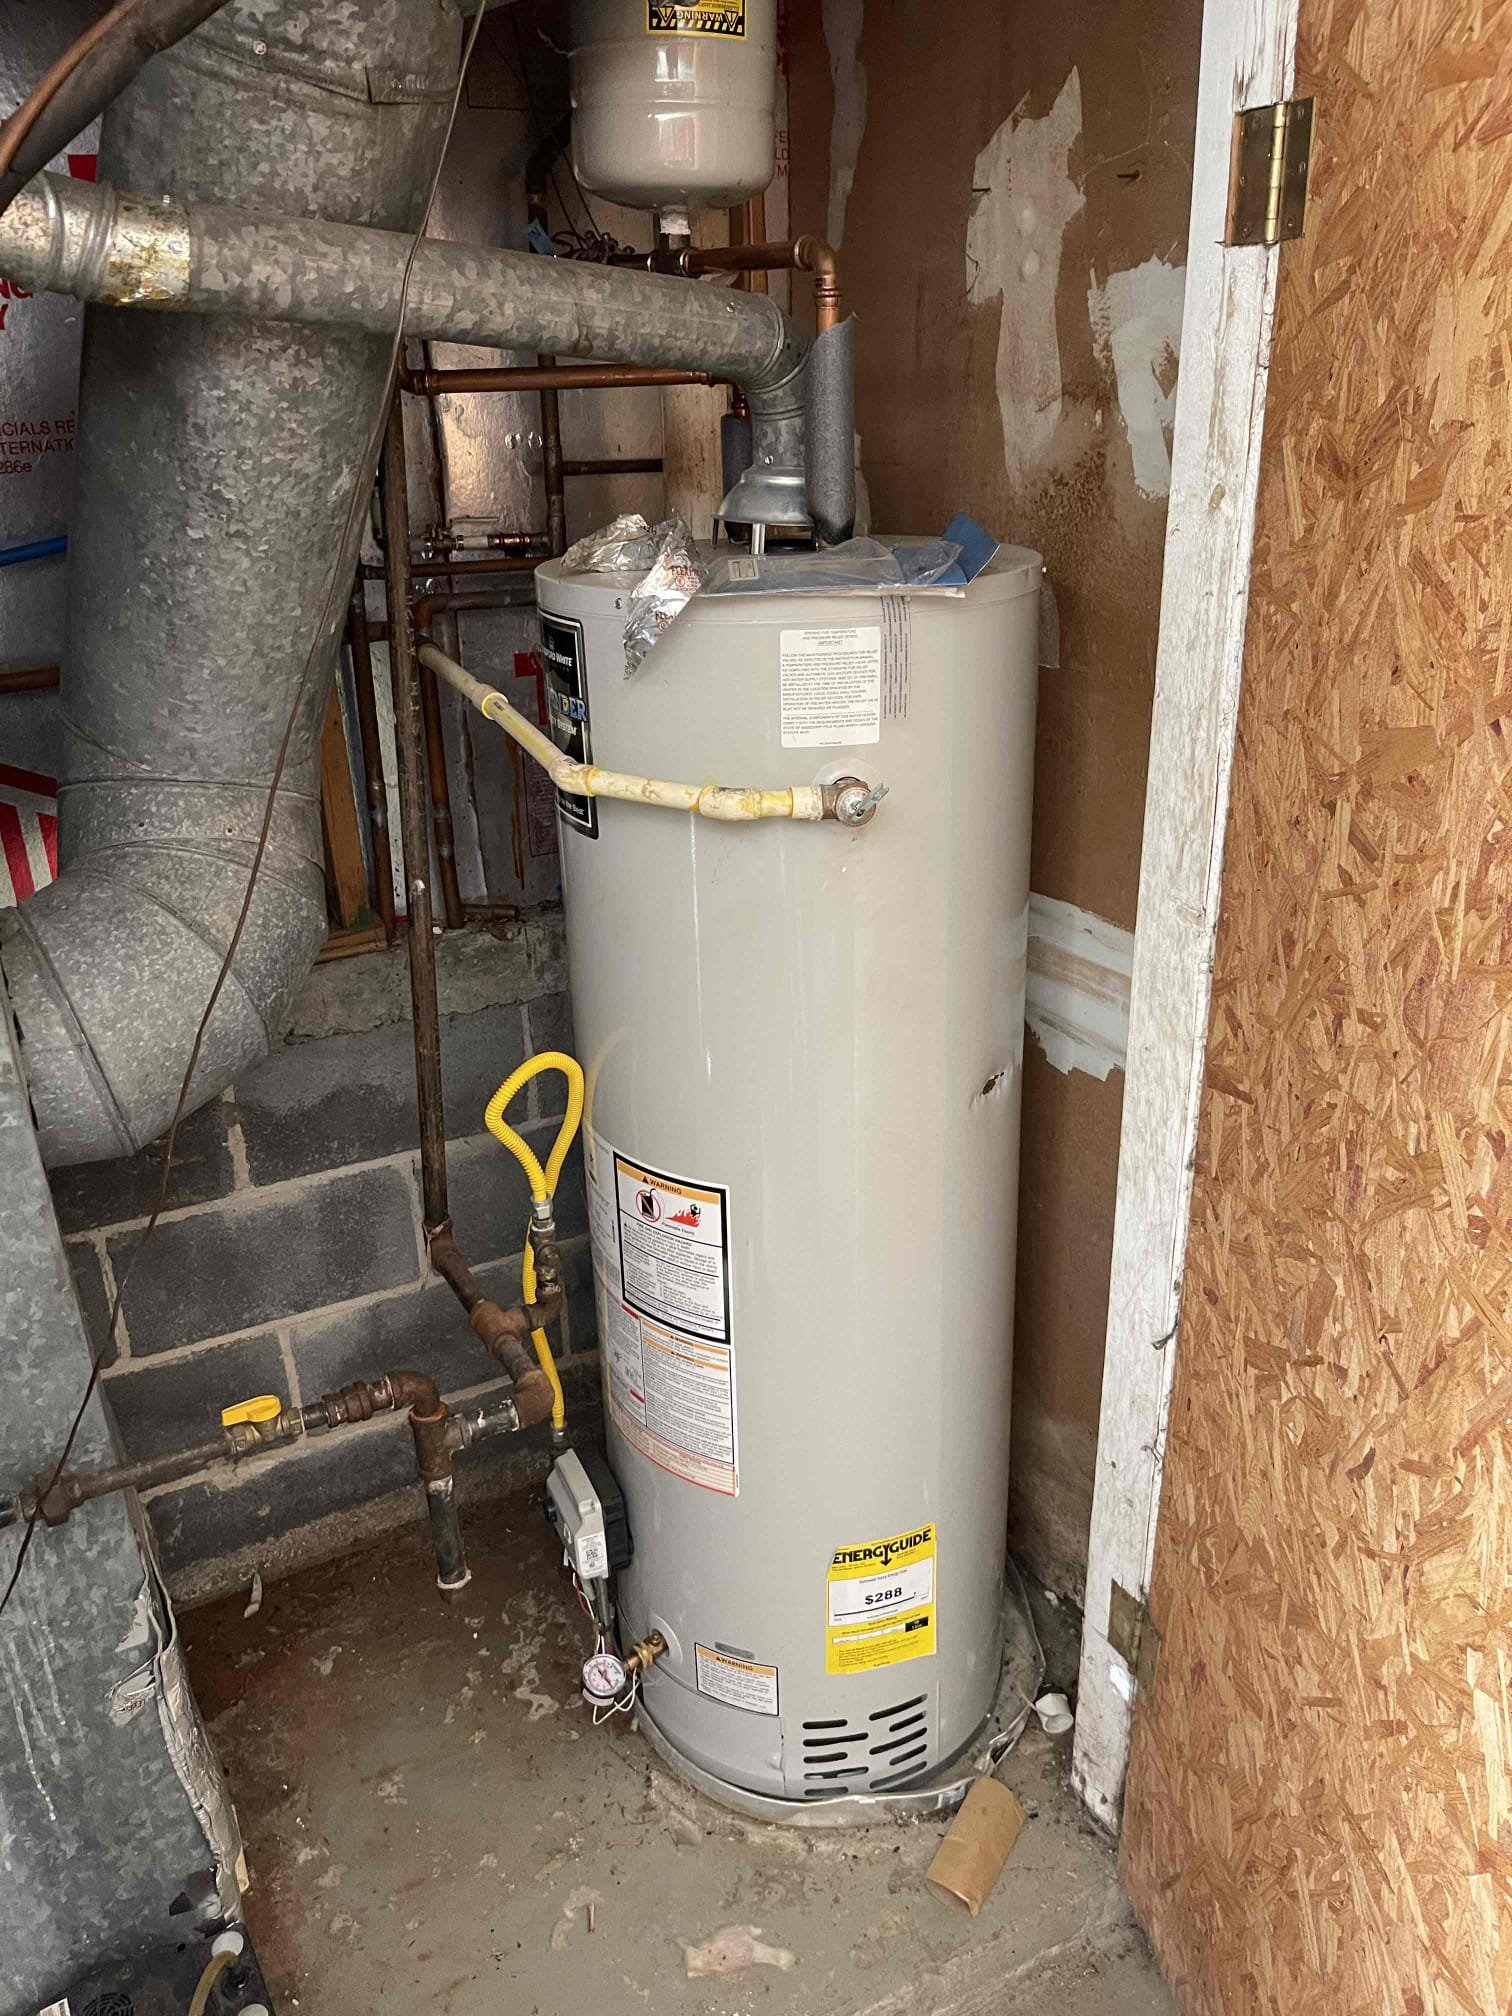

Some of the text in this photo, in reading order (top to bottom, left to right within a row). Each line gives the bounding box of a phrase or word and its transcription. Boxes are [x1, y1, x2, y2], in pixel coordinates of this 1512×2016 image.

[676, 10, 724, 22] WARNING
[556, 652, 573, 667] WHITE
[650, 1178, 682, 1195] WARNING
[832, 1529, 931, 1566] ENERGYGUIDE
[865, 1587, 902, 1605] $288
[721, 1656, 753, 1671] WARNING
